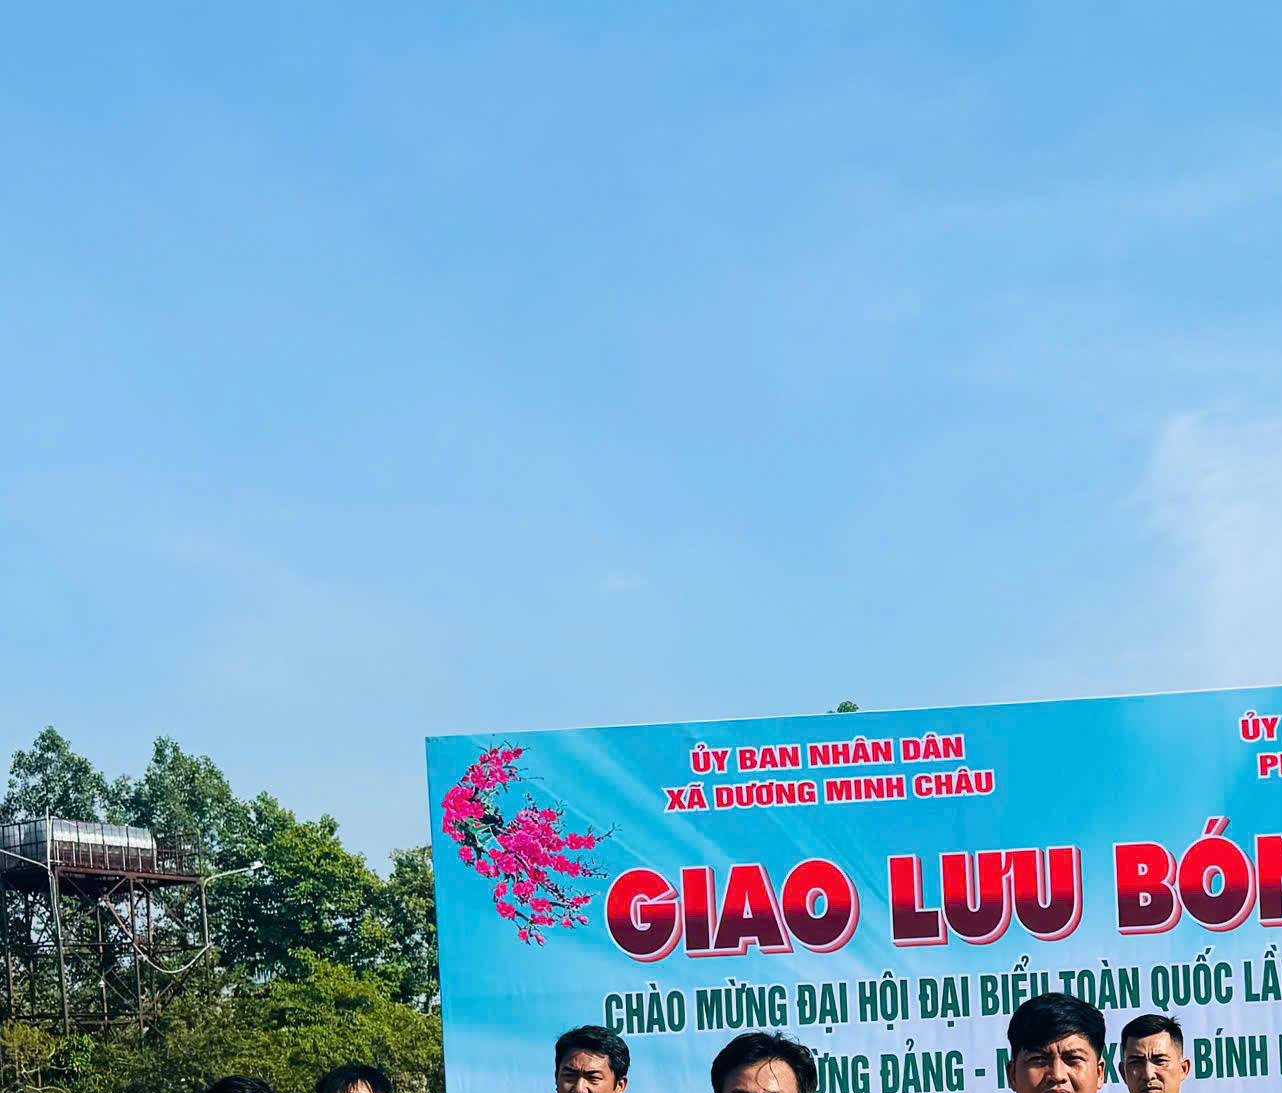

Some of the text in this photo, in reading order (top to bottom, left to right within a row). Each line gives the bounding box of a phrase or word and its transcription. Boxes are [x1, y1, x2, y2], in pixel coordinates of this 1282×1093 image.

[1240, 710, 1279, 740] ỦY
[691, 733, 964, 775] ỦY BAN NHÂN DÂN
[666, 768, 994, 812] XÃ DƯƠNG MINH CHÂU
[606, 858, 859, 962] GIAO
[887, 846, 1083, 946] LƯU
[605, 983, 686, 1033] CHÀO
[696, 978, 788, 1030] MỪNG
[797, 983, 847, 1036] ĐẠI
[858, 971, 909, 1031] HỘI
[918, 976, 969, 1028] ĐẠI
[1059, 960, 1140, 1010] TOÀN
[1151, 948, 1233, 1012] QUỐC
[975, 1069, 985, 1077] -
[1194, 1027, 1268, 1079] BÍNH
